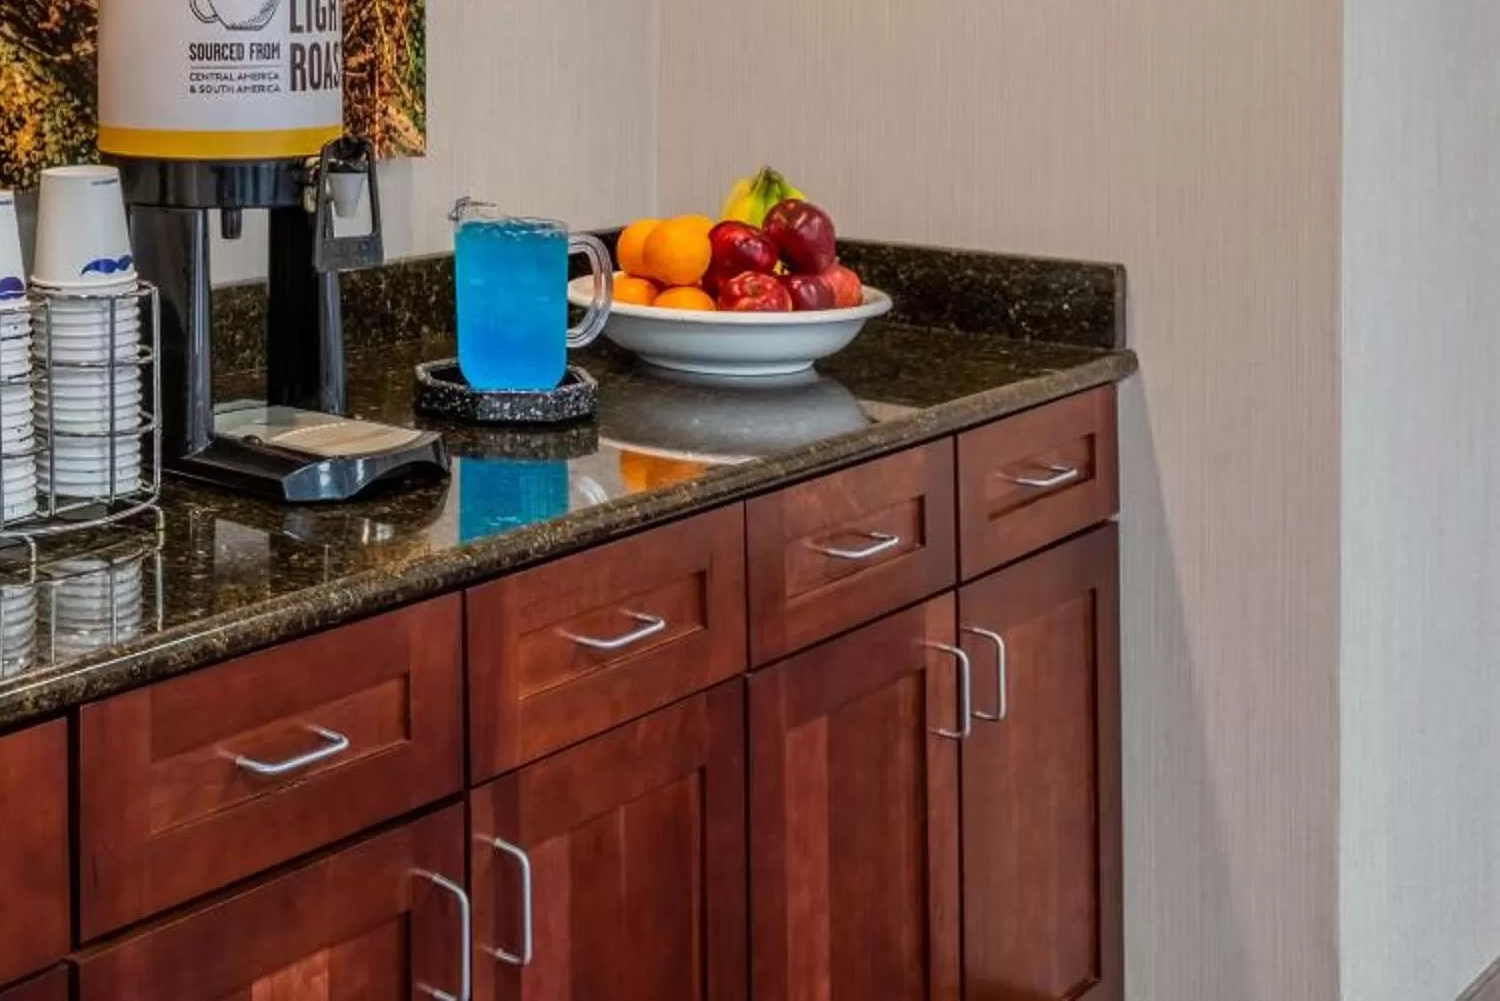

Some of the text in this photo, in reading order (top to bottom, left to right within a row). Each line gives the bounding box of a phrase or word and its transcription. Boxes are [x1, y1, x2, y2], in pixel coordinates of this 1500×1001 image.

[189, 42, 281, 61] SOURCED FROM
[290, 41, 340, 92] ROAS
[189, 72, 280, 82] CENTRAL AMERICA
[198, 84, 235, 94] SOUTH
[236, 84, 282, 94] AMERICA
